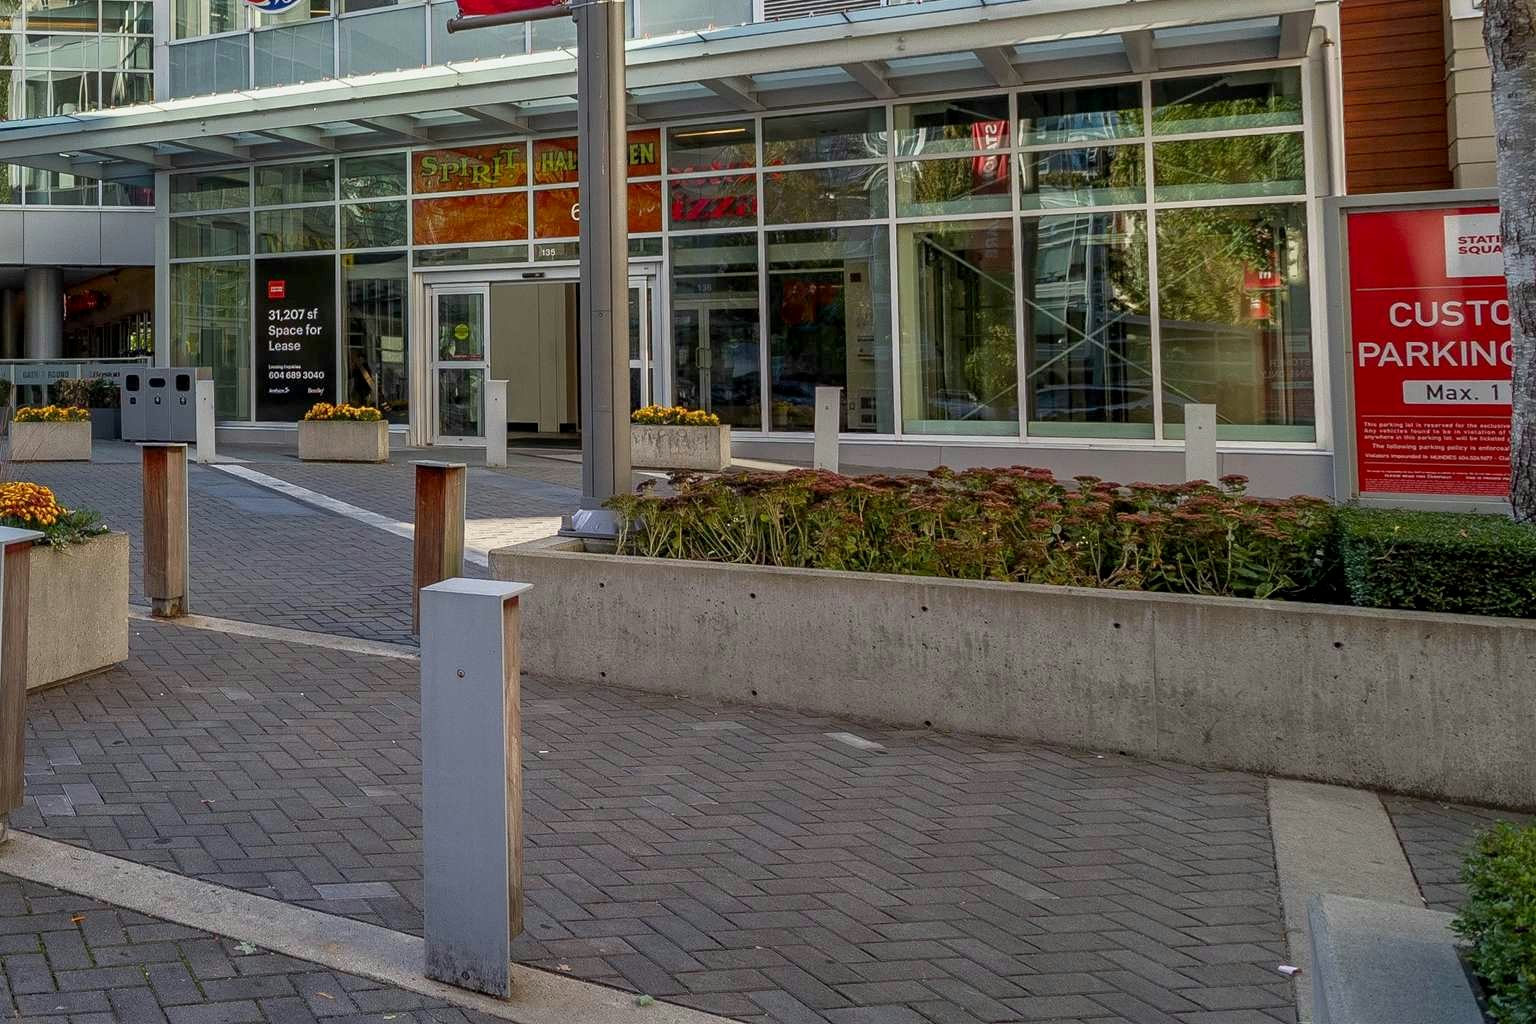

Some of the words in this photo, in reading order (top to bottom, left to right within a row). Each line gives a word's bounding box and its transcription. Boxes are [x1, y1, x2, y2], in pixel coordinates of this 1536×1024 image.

[420, 148, 520, 185] SPIRIT
[541, 142, 655, 173] HALEN
[1457, 234, 1505, 245] STATI
[541, 248, 556, 257] 135
[1457, 244, 1503, 255] SQUA
[268, 309, 305, 322] 31,207
[306, 308, 318, 320] sf
[1389, 300, 1511, 328] CUSTO
[268, 325, 303, 338] Space
[305, 324, 322, 336] for
[268, 340, 301, 351] Lease
[268, 371, 284, 379] 604
[302, 371, 325, 379] 3040
[1426, 384, 1480, 401] Max.
[1491, 383, 1500, 400] 1
